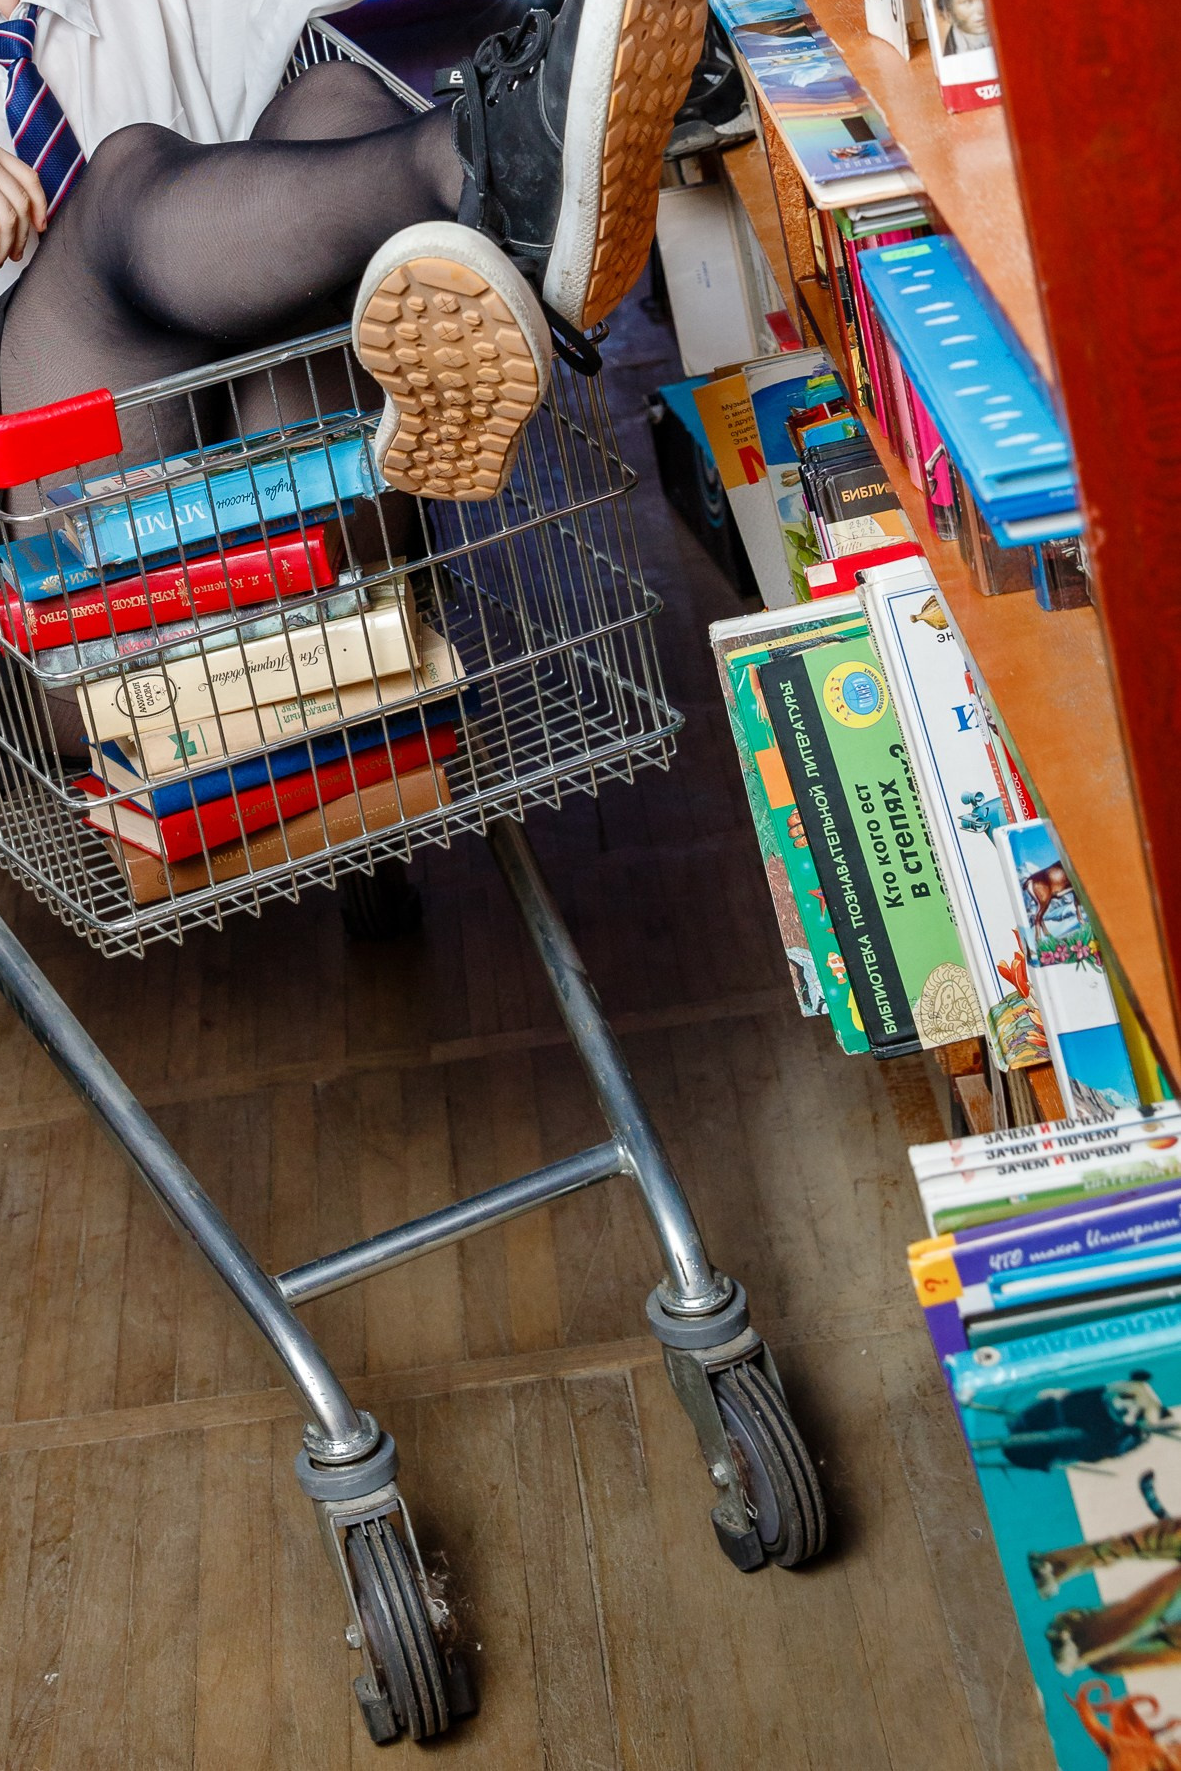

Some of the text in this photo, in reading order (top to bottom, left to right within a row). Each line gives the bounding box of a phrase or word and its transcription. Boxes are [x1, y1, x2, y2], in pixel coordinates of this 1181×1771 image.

[214, 490, 260, 509] Янссон
[121, 499, 208, 540] МУМИ
[246, 574, 259, 584] Я.
[38, 588, 176, 624] КУБАНСКОЕ КАЗАЧСТВО
[425, 661, 439, 685] 1983
[132, 680, 147, 714] АЛХИМИЯ
[142, 681, 154, 707] СЛОВА
[878, 778, 919, 868] степях
[779, 679, 898, 1035] БИБЛИОТЕКА ПОЗНАВАТЕЛЬНОЙ ЛИТЕРАТУРЫ
[855, 782, 906, 909] Кто кого ест
[983, 1111, 1116, 1145] ЗАЧЕМ И ПОЧЕМУ
[986, 1127, 1119, 1160] ЗАЧЕМ И ПОЧЕМУ
[997, 1142, 1132, 1176] ЗАЧЕМ И ПОЧЕМУ
[988, 1247, 1024, 1271] ЧТО
